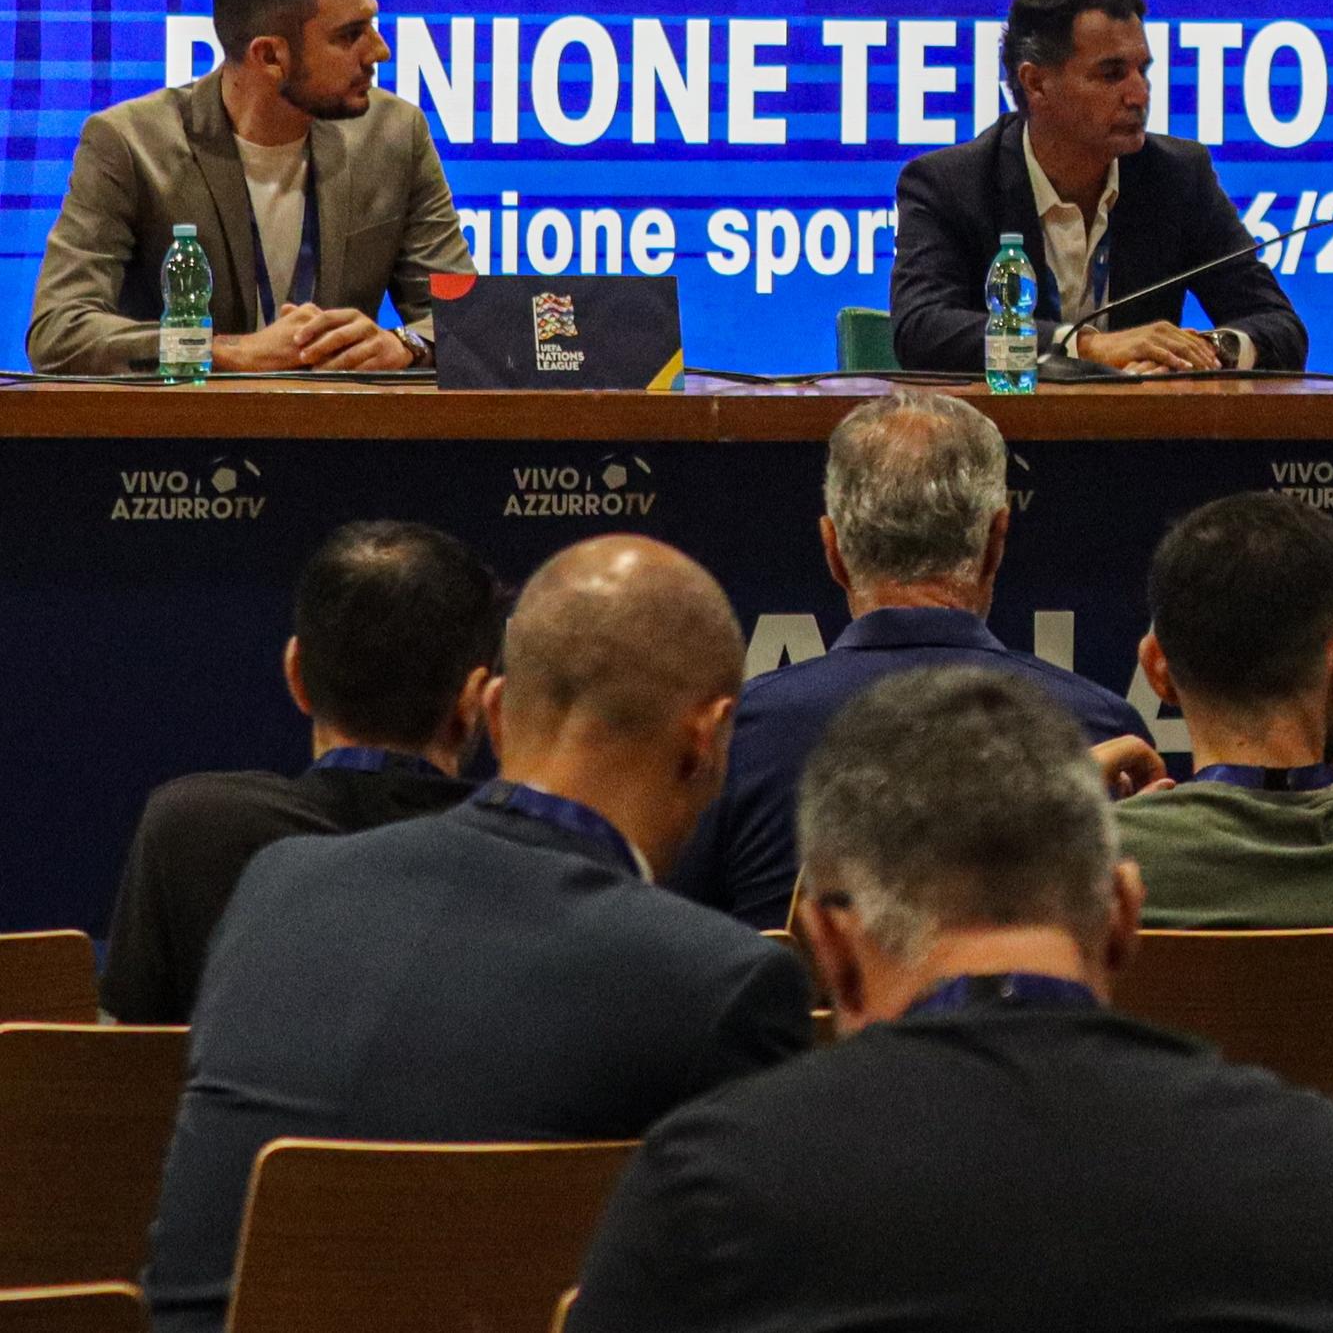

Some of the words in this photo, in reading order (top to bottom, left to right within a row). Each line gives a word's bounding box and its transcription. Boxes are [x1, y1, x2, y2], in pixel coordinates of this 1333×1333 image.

[165, 15, 787, 146] NIONE
[536, 352, 585, 361] NATIONS
[537, 361, 580, 371] LEAGUE
[121, 471, 189, 494] VIVO
[513, 468, 580, 490] VIVO
